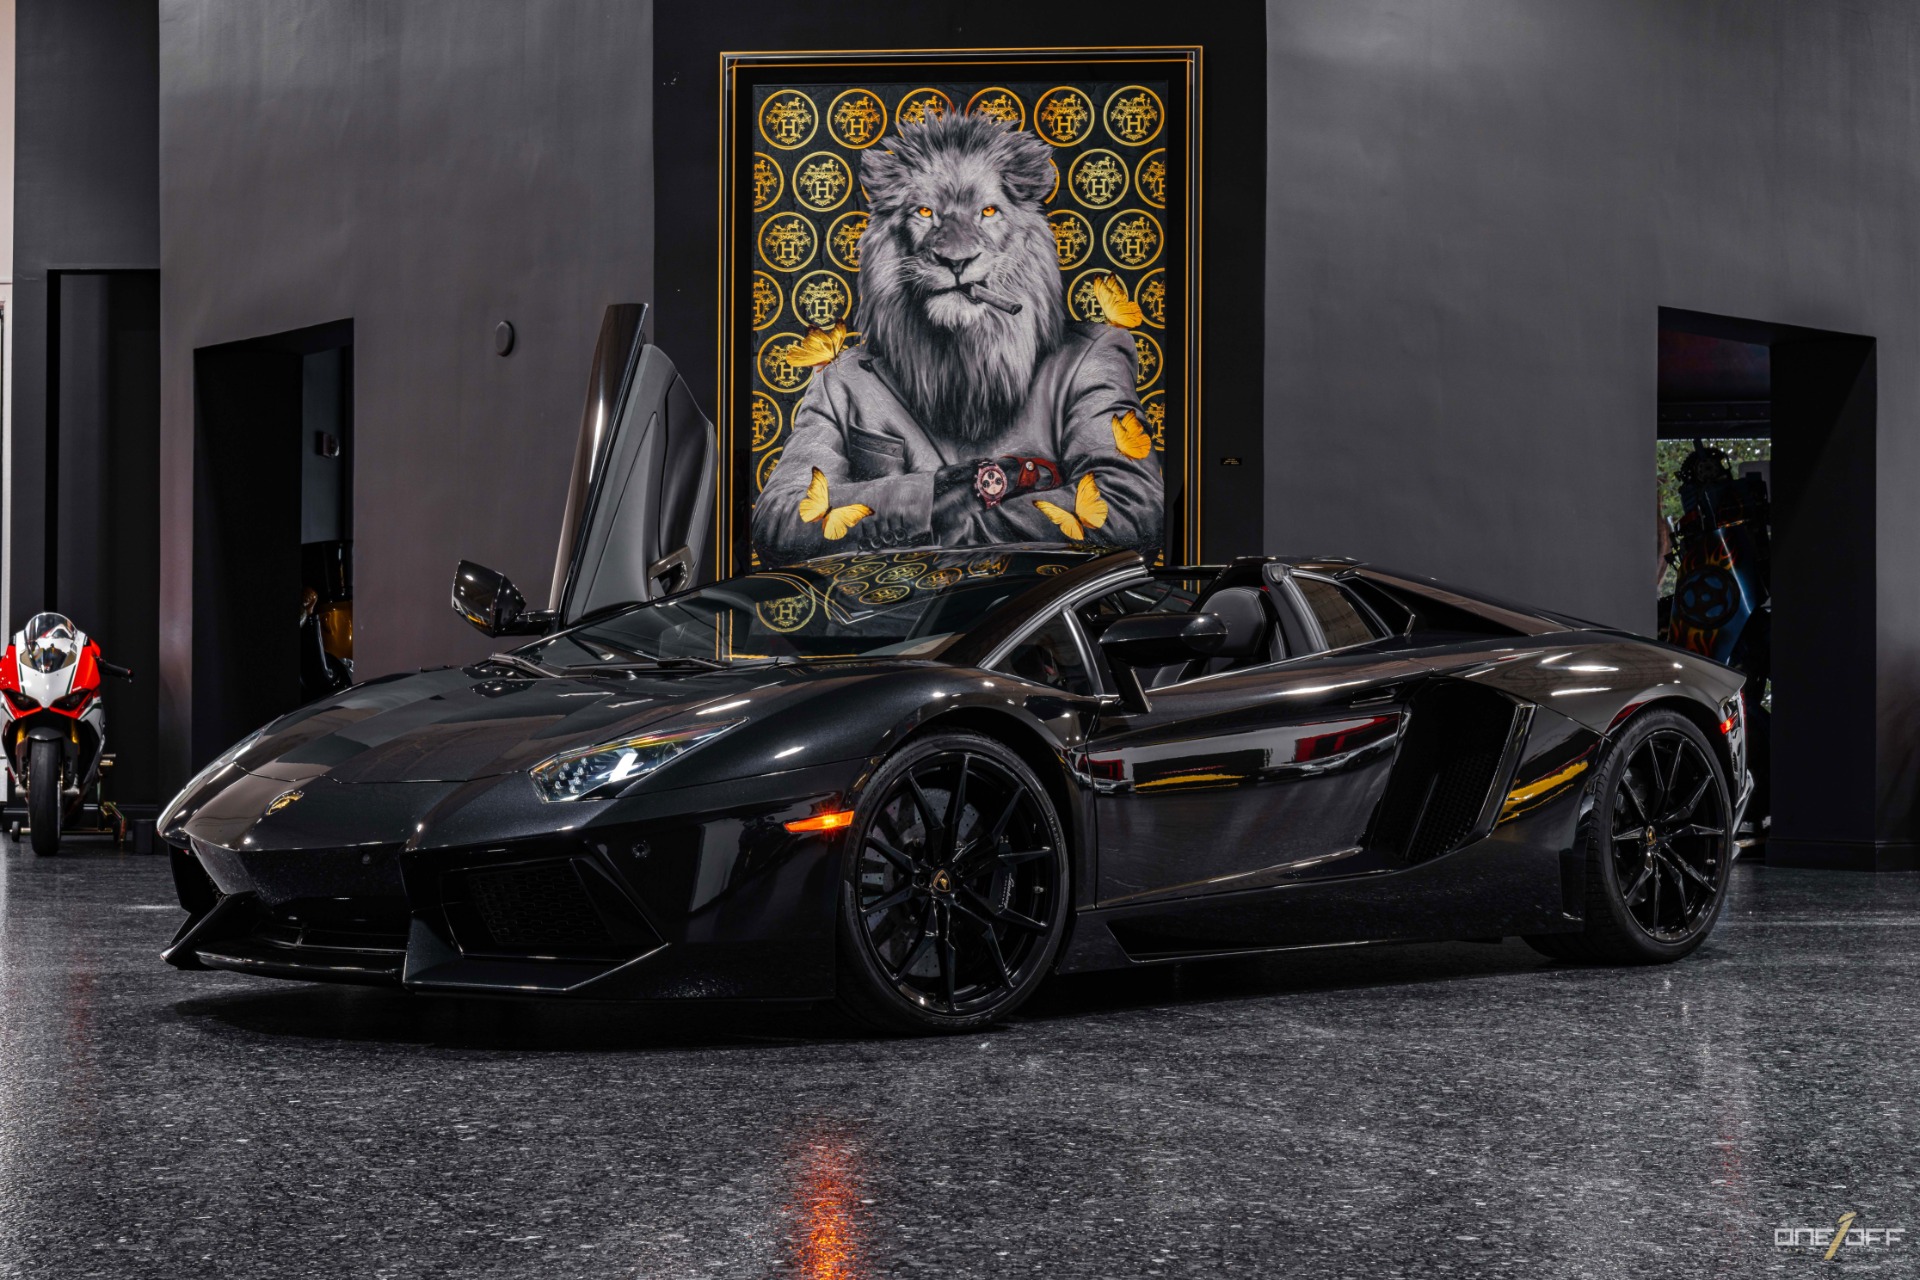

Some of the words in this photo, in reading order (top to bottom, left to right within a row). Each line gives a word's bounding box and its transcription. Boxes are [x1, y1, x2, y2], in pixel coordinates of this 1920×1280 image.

[781, 119, 796, 136] H
[850, 118, 865, 136] H
[1057, 115, 1072, 133] H
[1126, 115, 1142, 133] H
[815, 181, 830, 199] H
[1091, 178, 1107, 196] H
[780, 241, 796, 259] H
[1056, 239, 1072, 257] H
[1125, 238, 1142, 256] H
[815, 299, 830, 317] H
[779, 362, 795, 380] H
